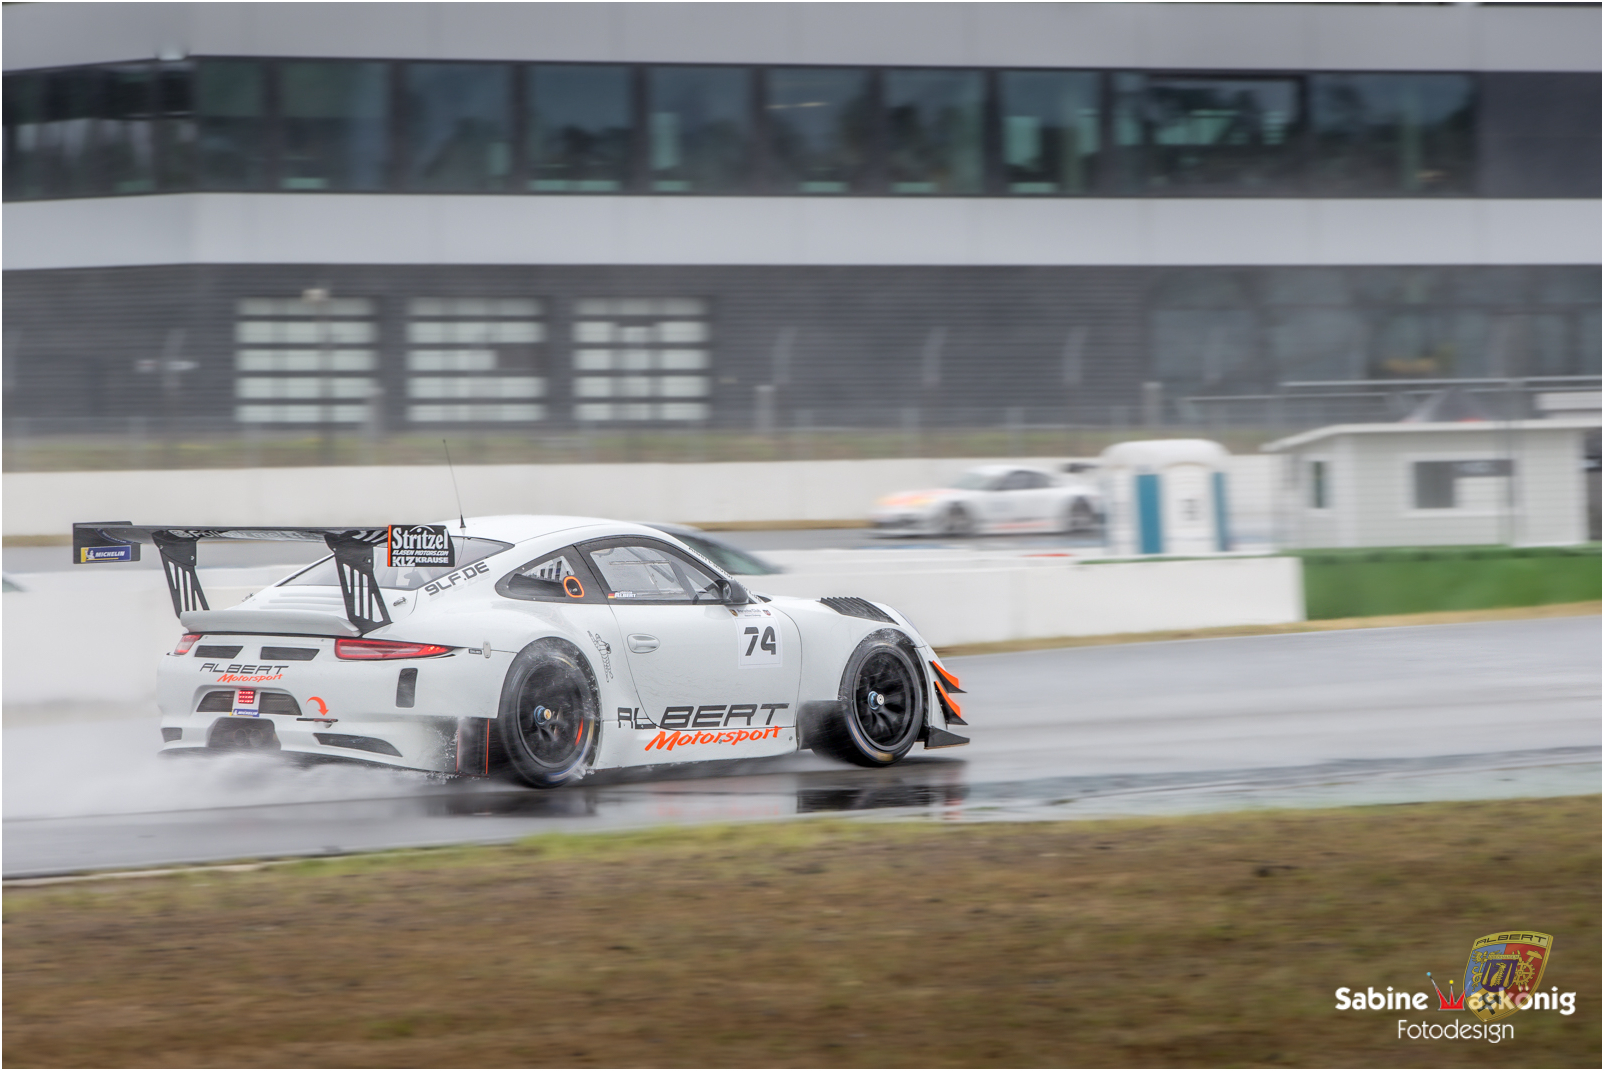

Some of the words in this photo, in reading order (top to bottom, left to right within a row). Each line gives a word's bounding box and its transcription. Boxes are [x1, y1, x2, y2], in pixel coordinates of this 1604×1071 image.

[391, 527, 449, 550] Stritzel
[95, 550, 125, 558] MICHELIN
[392, 556, 416, 567] KLZ
[415, 556, 449, 564] KRAUSE
[424, 561, 490, 596] 9LF.DE
[743, 625, 777, 657] 74
[200, 662, 289, 675] ALBERT
[216, 673, 284, 683] Motorsport
[617, 703, 790, 730] ALBERT
[644, 725, 783, 751] Motorsport
